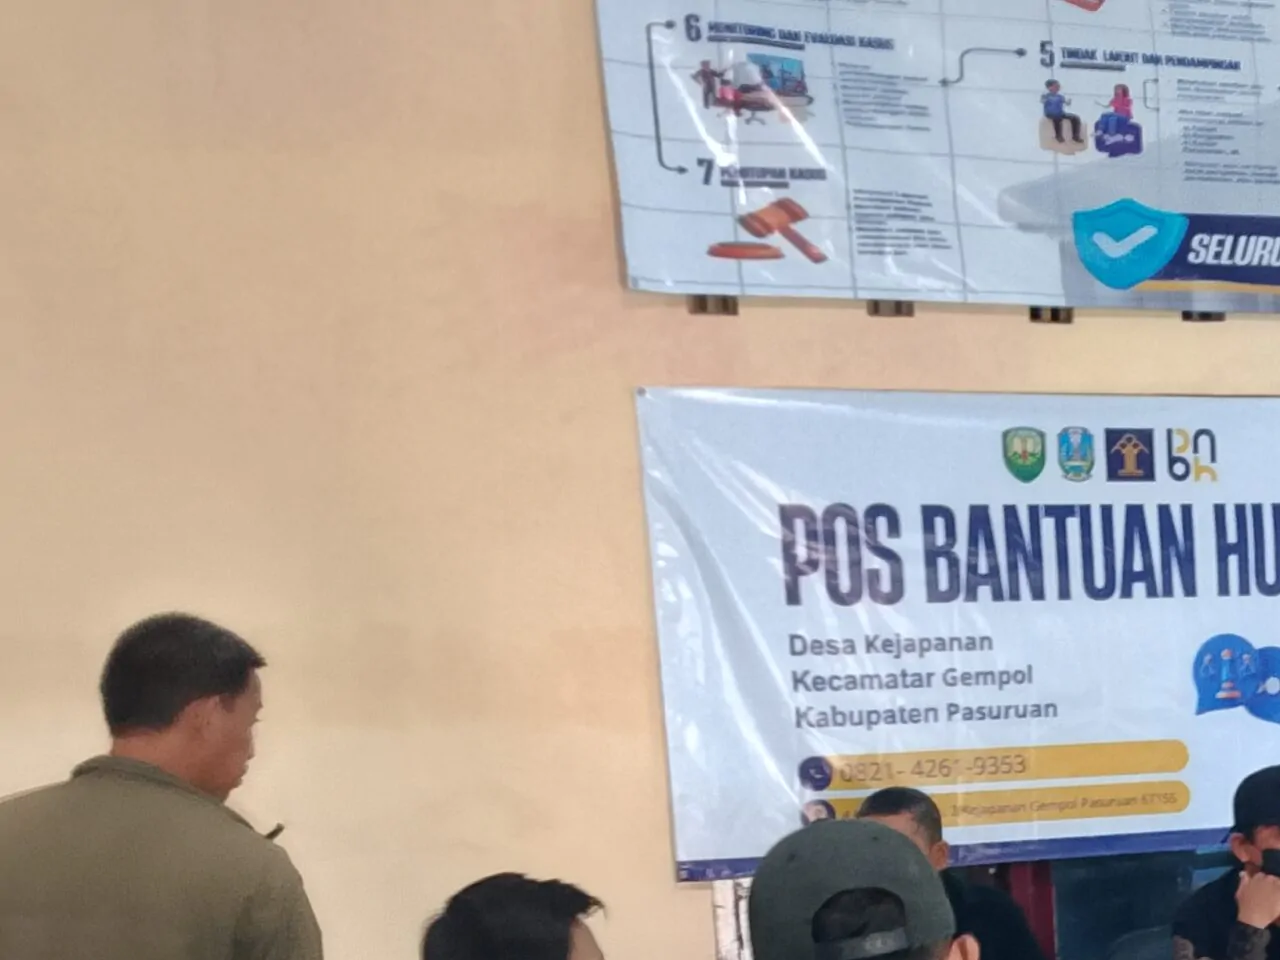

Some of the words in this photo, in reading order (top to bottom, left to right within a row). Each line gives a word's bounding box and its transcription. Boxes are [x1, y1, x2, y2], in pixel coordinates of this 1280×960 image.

[685, 14, 701, 42] 6
[1040, 40, 1055, 67] 5
[696, 157, 714, 186] 7
[778, 502, 905, 607] POS
[920, 502, 1198, 604] BANTUAN
[789, 634, 857, 656] Desa
[864, 634, 993, 659] Kejapanan
[942, 665, 1034, 690] Gempol
[795, 704, 940, 730] Kabupaten
[946, 702, 1058, 722] Pasuruan
